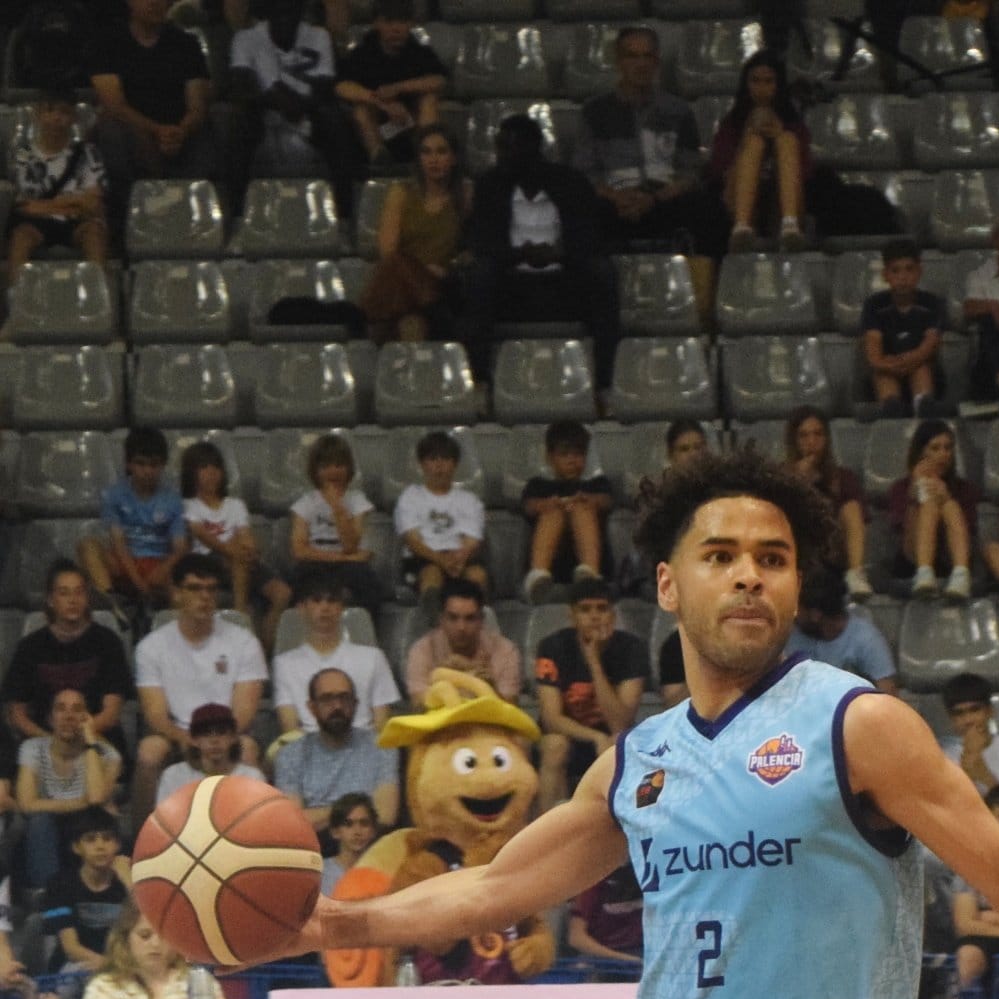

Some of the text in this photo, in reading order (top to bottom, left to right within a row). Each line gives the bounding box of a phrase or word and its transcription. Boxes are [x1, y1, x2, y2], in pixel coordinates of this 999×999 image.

[749, 751, 802, 769] PALENCIA
[662, 829, 802, 876] zunder
[695, 919, 725, 989] 2
